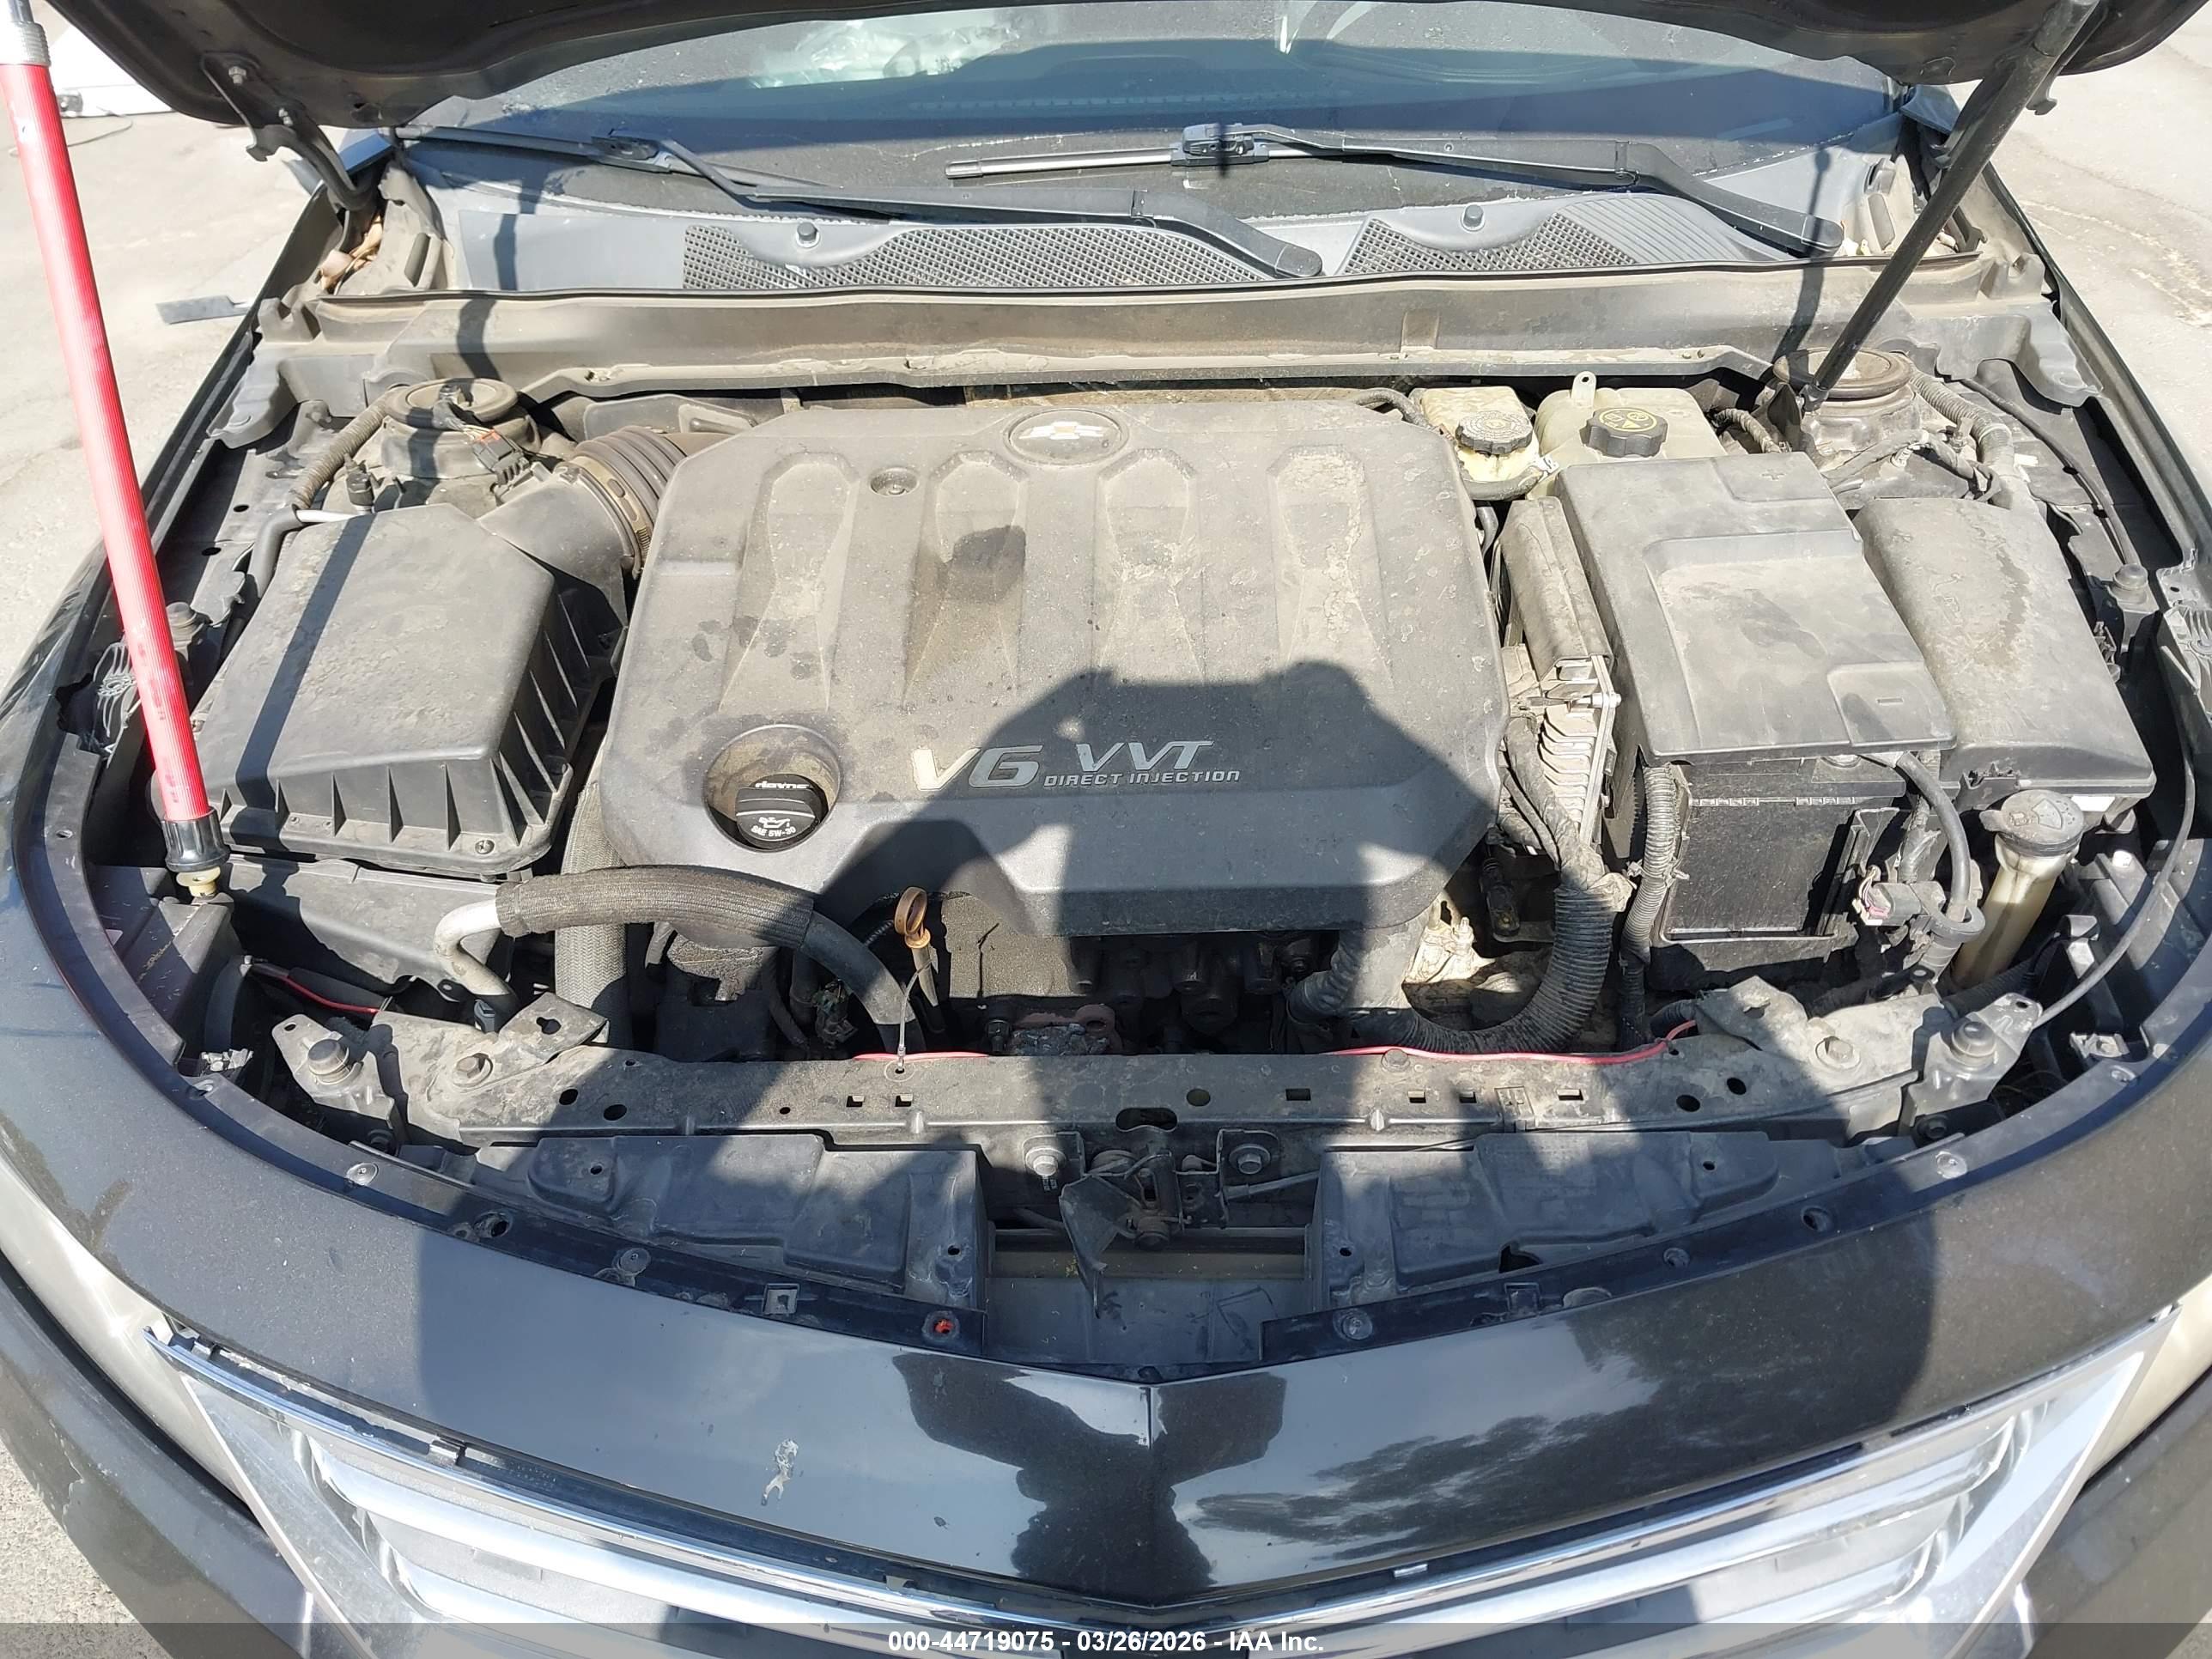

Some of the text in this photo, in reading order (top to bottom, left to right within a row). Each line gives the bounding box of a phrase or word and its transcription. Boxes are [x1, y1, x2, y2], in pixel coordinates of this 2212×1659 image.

[912, 739, 1215, 792] V6 VVT
[1043, 769, 1241, 787] DIRECT INJECTION
[750, 825, 797, 837] SAE 5W-30
